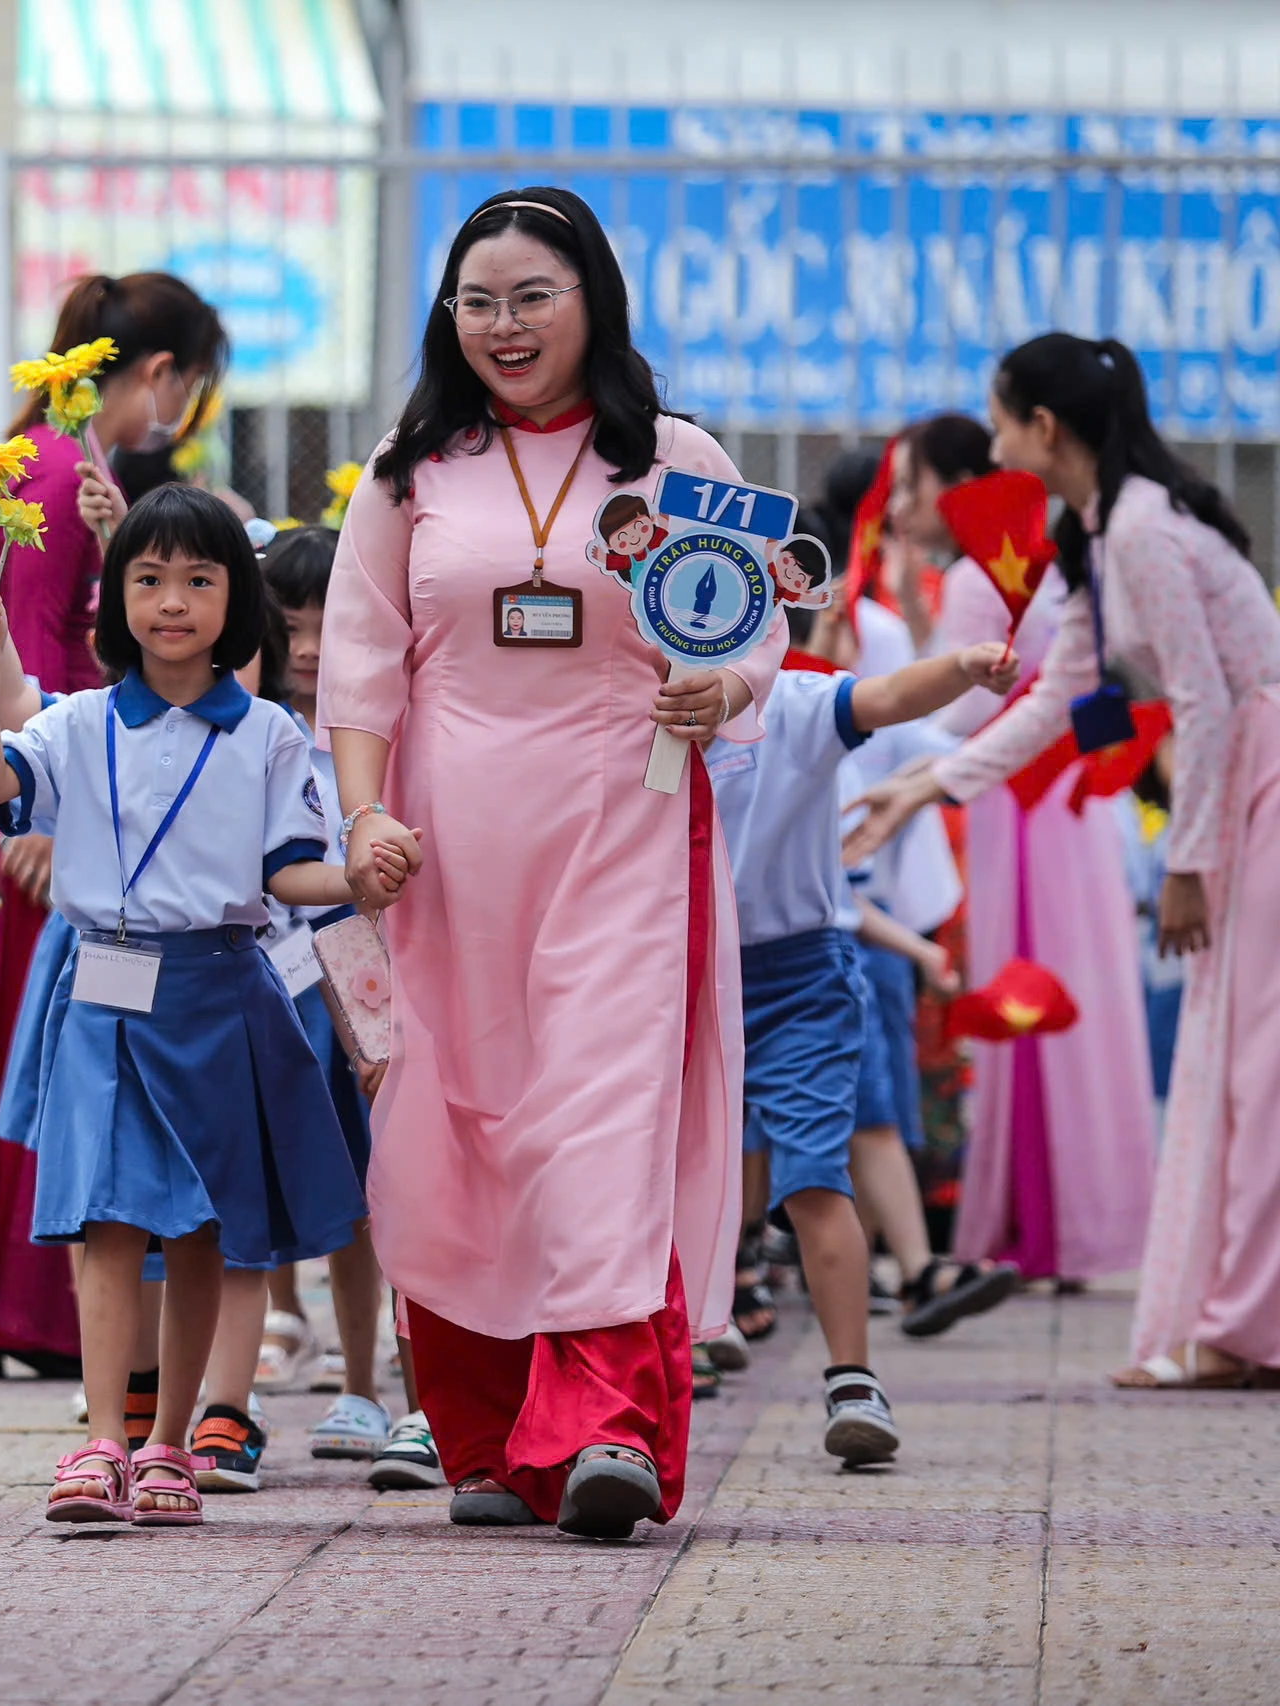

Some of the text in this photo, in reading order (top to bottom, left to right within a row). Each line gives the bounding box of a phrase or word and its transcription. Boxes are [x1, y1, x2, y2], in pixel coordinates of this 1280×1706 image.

[693, 482, 757, 529] 1/1
[698, 538, 744, 560] HƯNG
[744, 561, 763, 595] ĐẠO
[656, 619, 690, 650] TRƯỜNG
[716, 636, 737, 650] HỌC
[740, 609, 759, 634] TP.HCM
